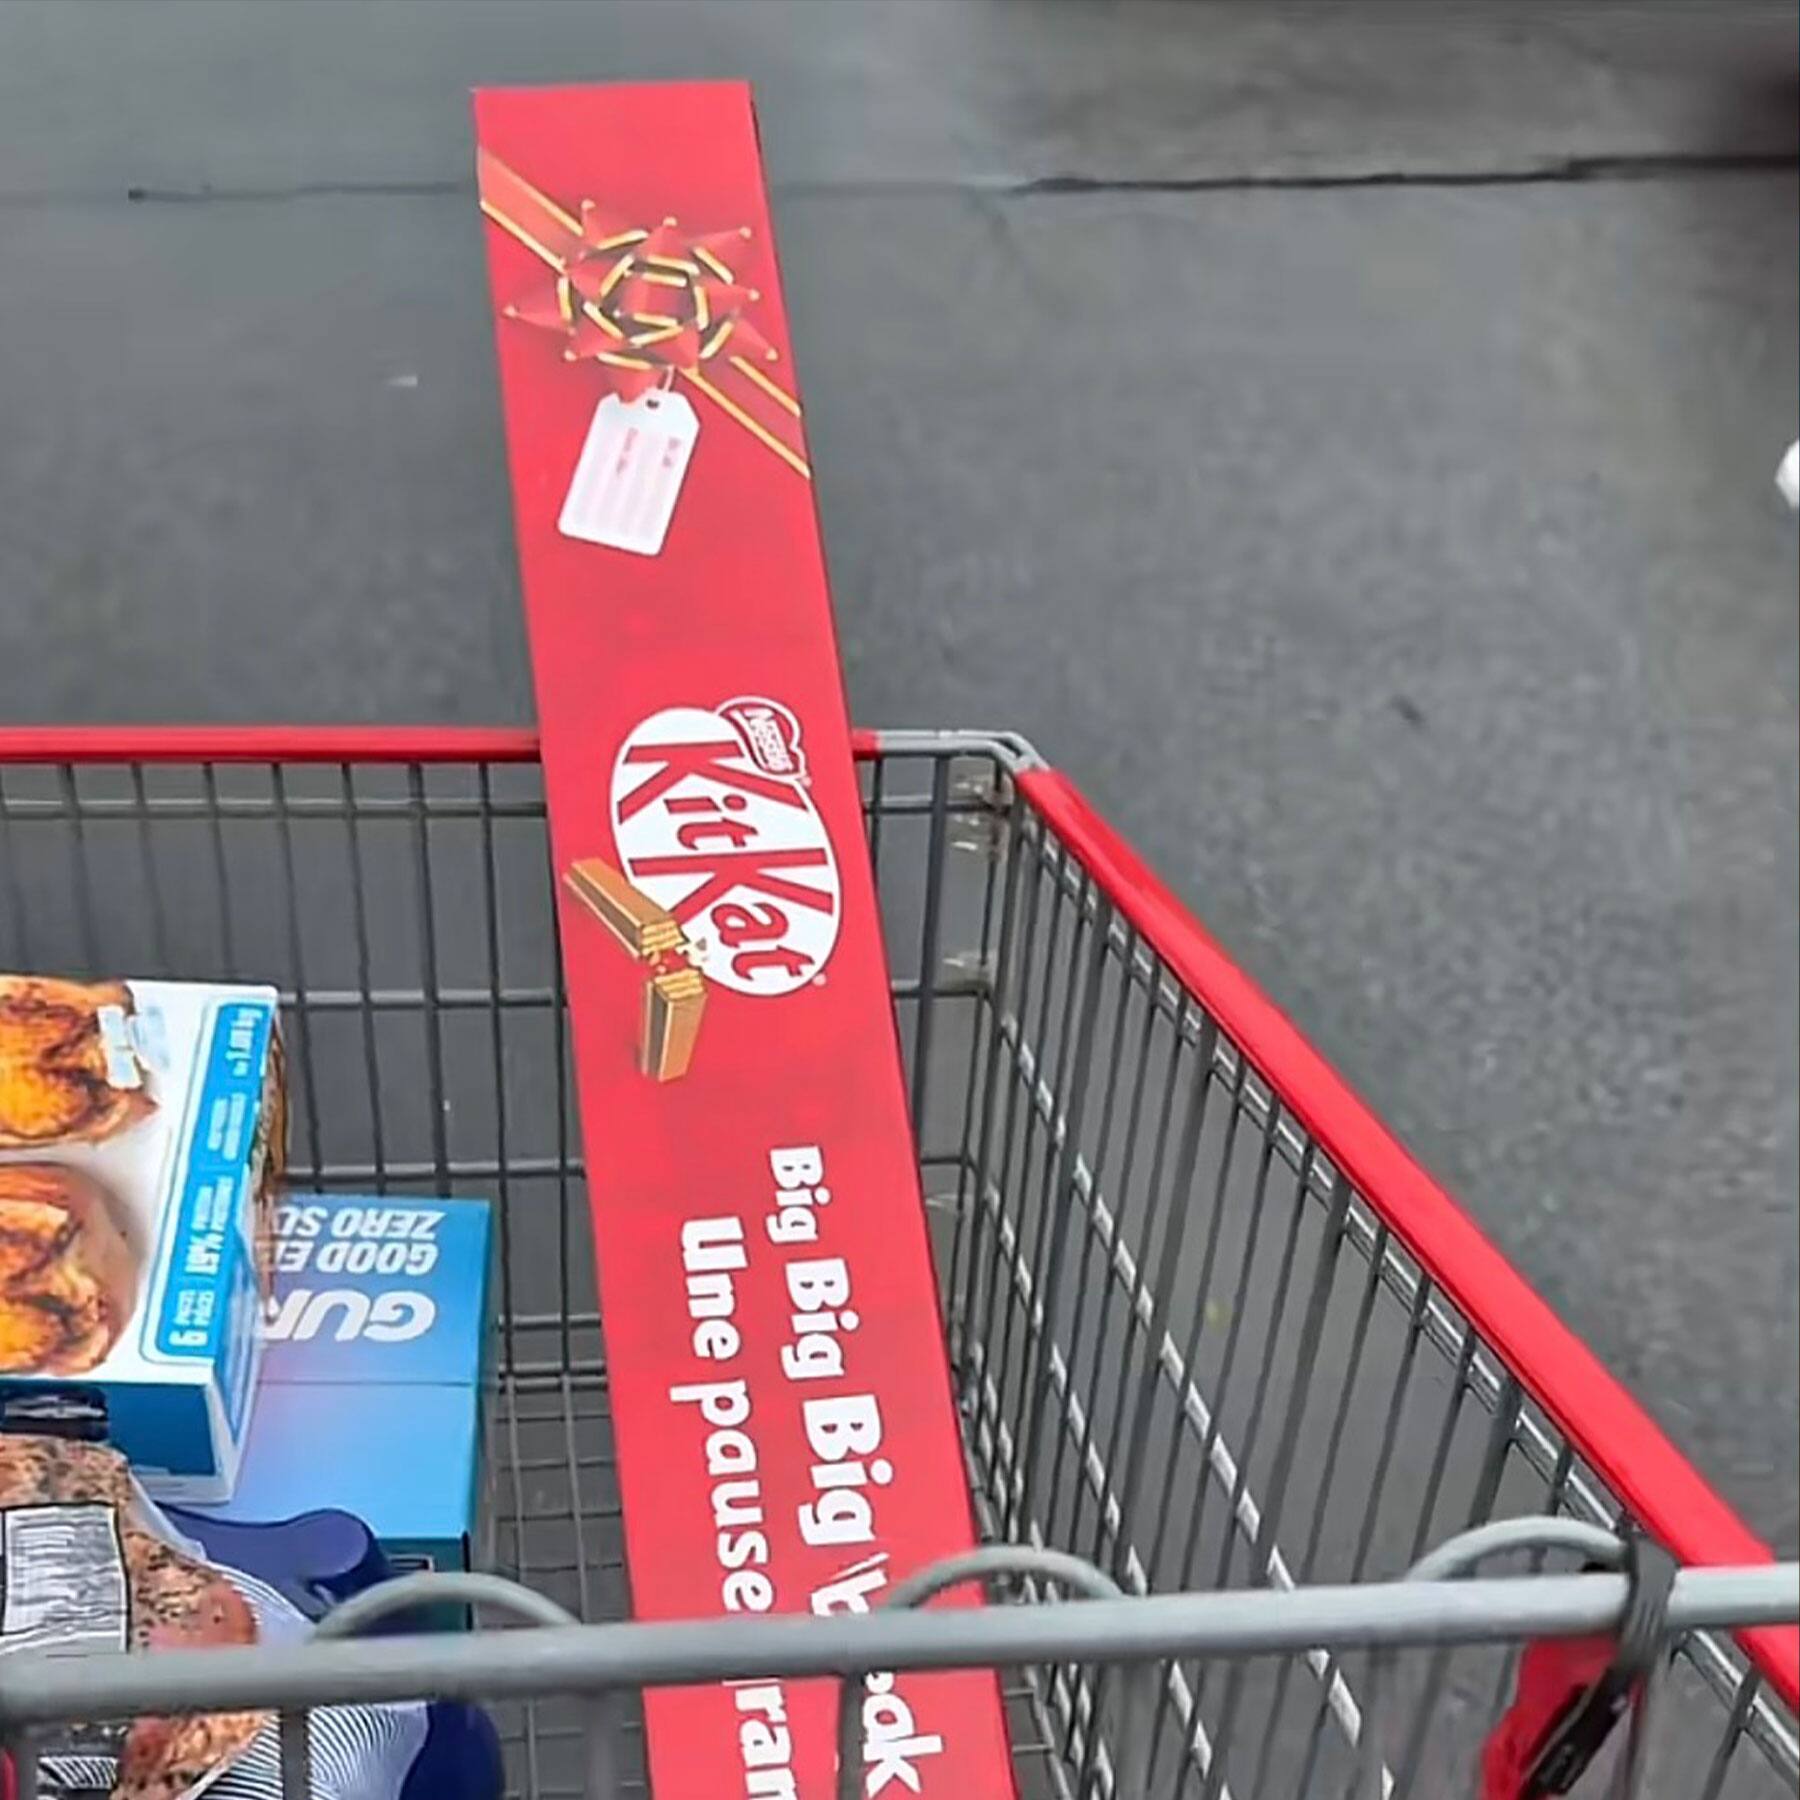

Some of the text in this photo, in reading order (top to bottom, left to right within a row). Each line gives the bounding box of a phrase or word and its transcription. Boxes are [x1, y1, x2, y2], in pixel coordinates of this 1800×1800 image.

[330, 1207, 448, 1240] ZERO
[766, 1146, 831, 1244] Big
[316, 1241, 438, 1275] GOOD
[681, 1215, 748, 1360] Une
[780, 1257, 860, 1379] Big
[670, 1379, 774, 1613] pause
[798, 1394, 893, 1545] Big
